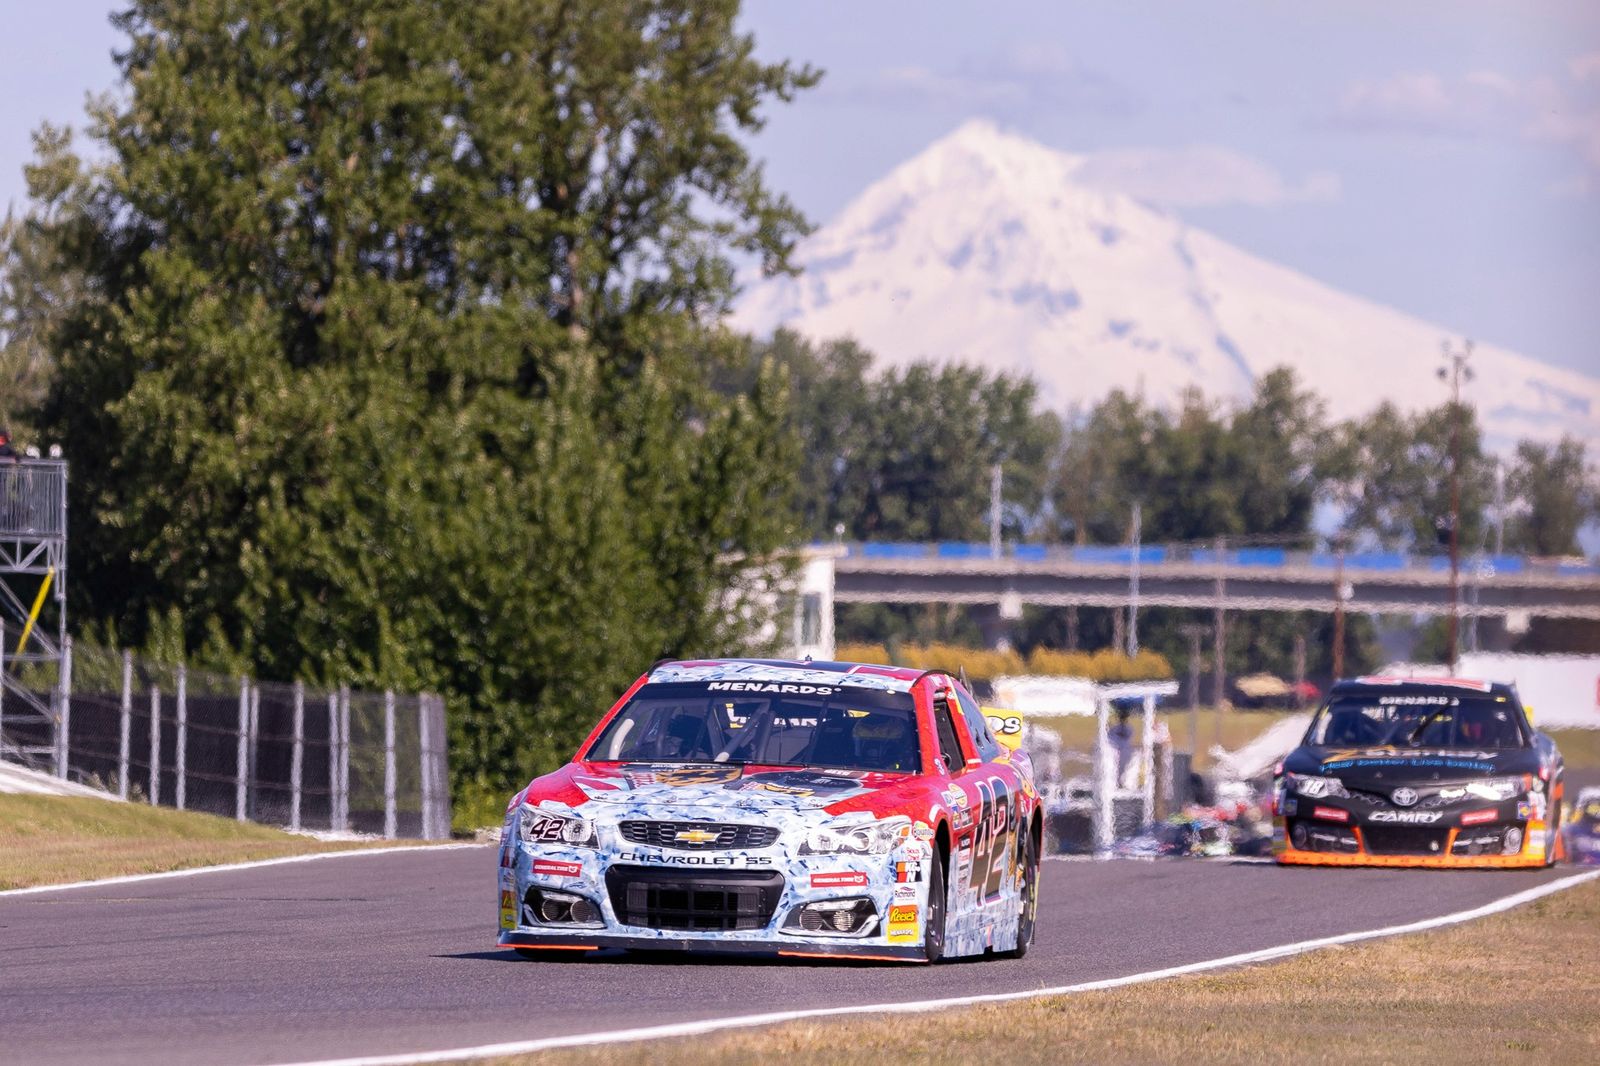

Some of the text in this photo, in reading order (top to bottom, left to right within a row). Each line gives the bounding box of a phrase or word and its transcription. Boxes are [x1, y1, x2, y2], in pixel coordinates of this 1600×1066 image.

[707, 682, 832, 695] MENARDS
[1368, 810, 1444, 823] CAMRY
[530, 818, 566, 840] 42
[619, 852, 772, 865] CHEVROLET SS
